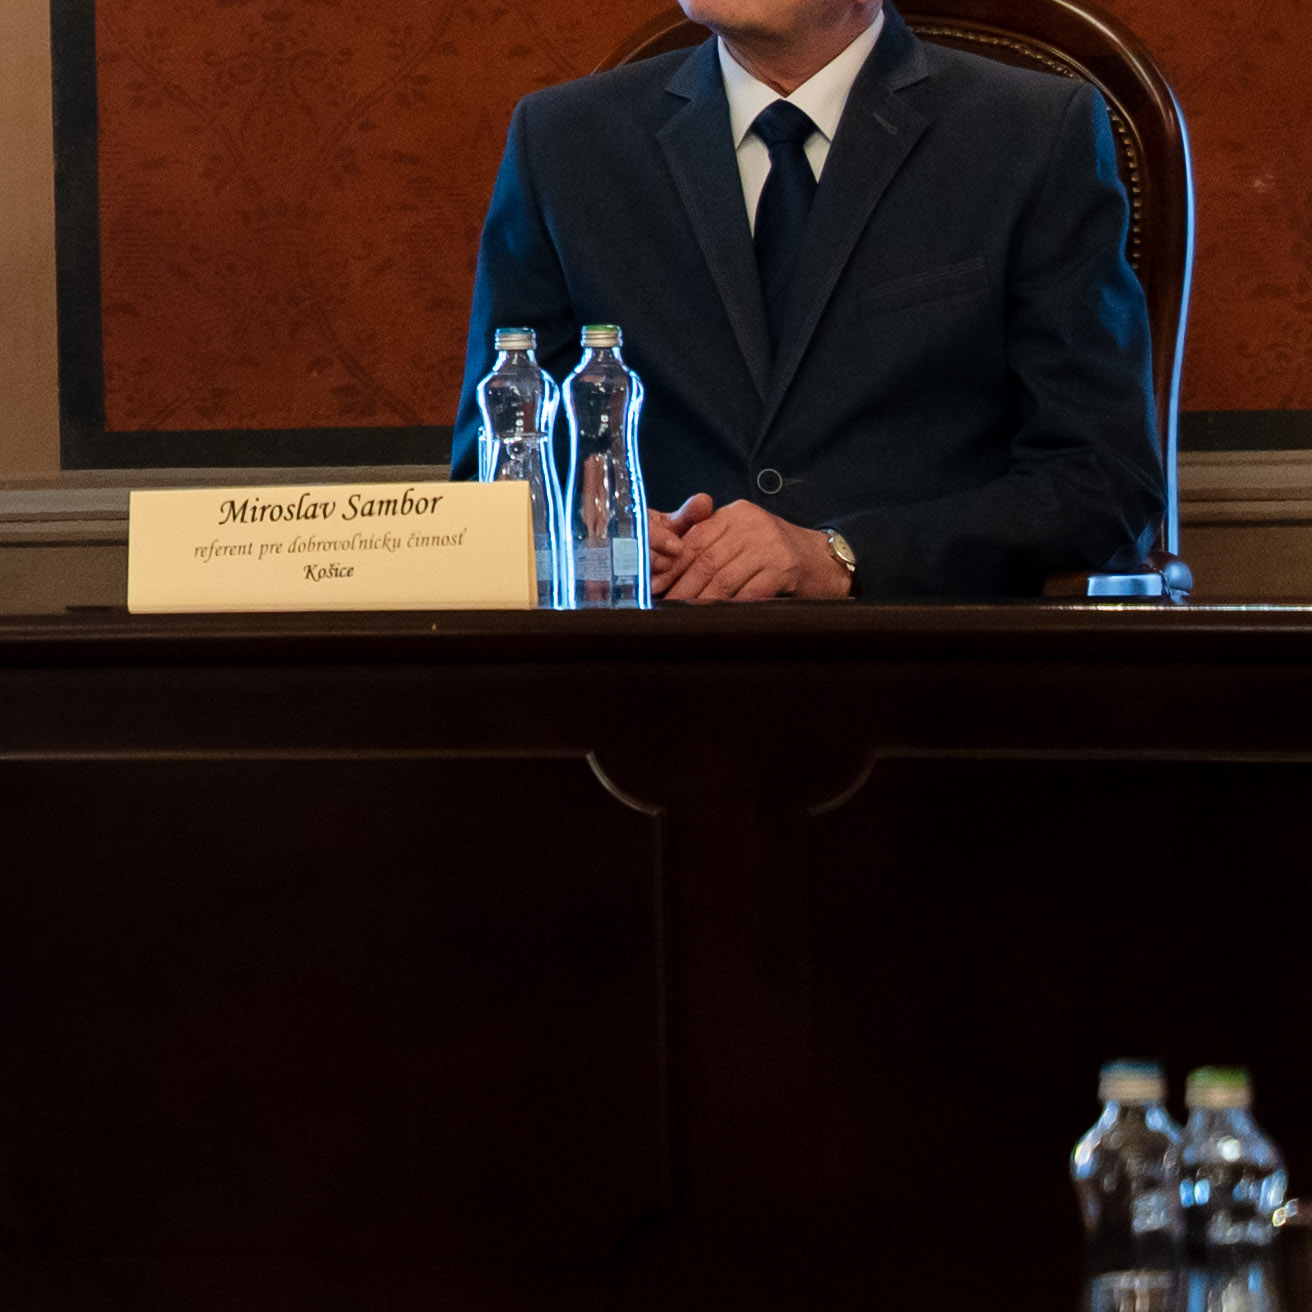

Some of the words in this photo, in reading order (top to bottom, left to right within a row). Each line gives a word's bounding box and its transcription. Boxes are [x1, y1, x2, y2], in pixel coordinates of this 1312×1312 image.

[218, 493, 335, 526] Miroslav
[342, 488, 443, 520] Sambor
[194, 540, 253, 563] referent
[258, 543, 283, 560] pre
[407, 527, 468, 548] činnosť
[303, 563, 354, 582] Košice
